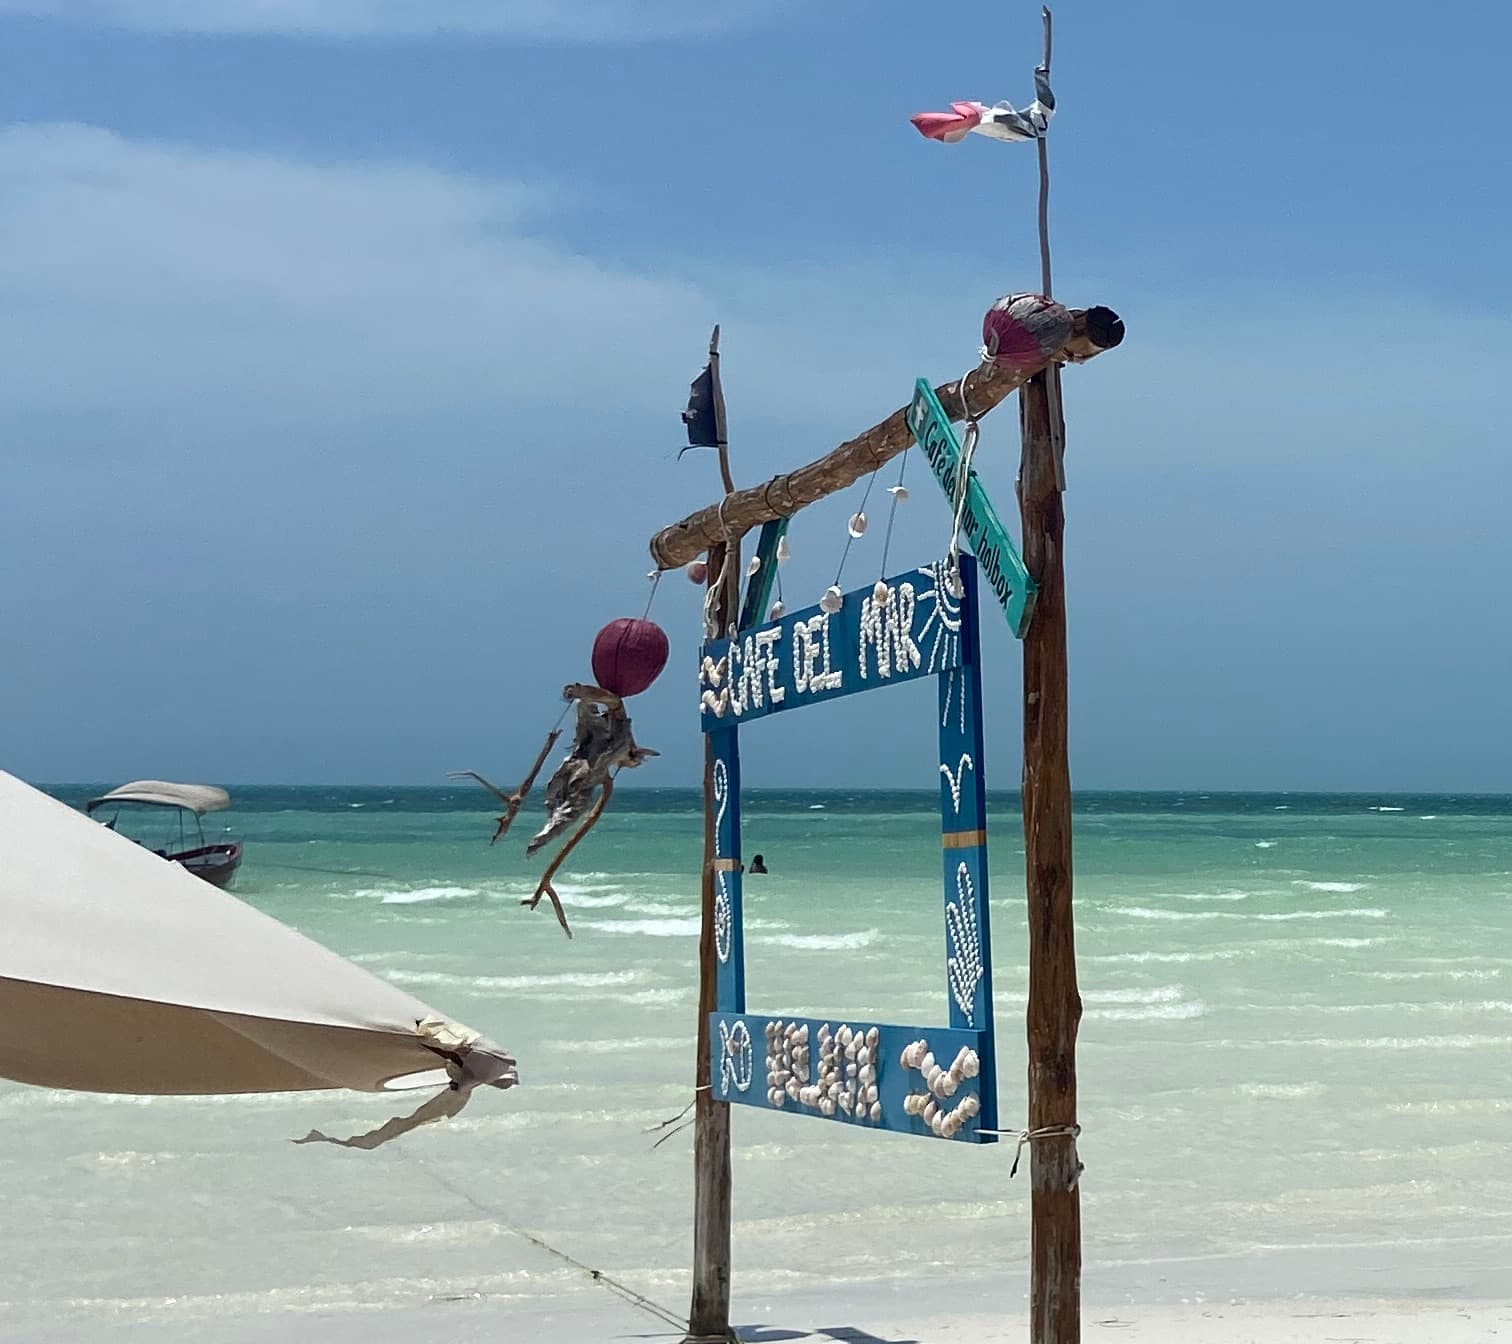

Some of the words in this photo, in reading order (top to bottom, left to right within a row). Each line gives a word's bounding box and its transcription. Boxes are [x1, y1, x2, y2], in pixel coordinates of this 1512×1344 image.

[977, 527, 1012, 609] holbox
[727, 625, 785, 716] CAFE
[793, 613, 842, 694] DEL
[859, 582, 921, 679] MAR
